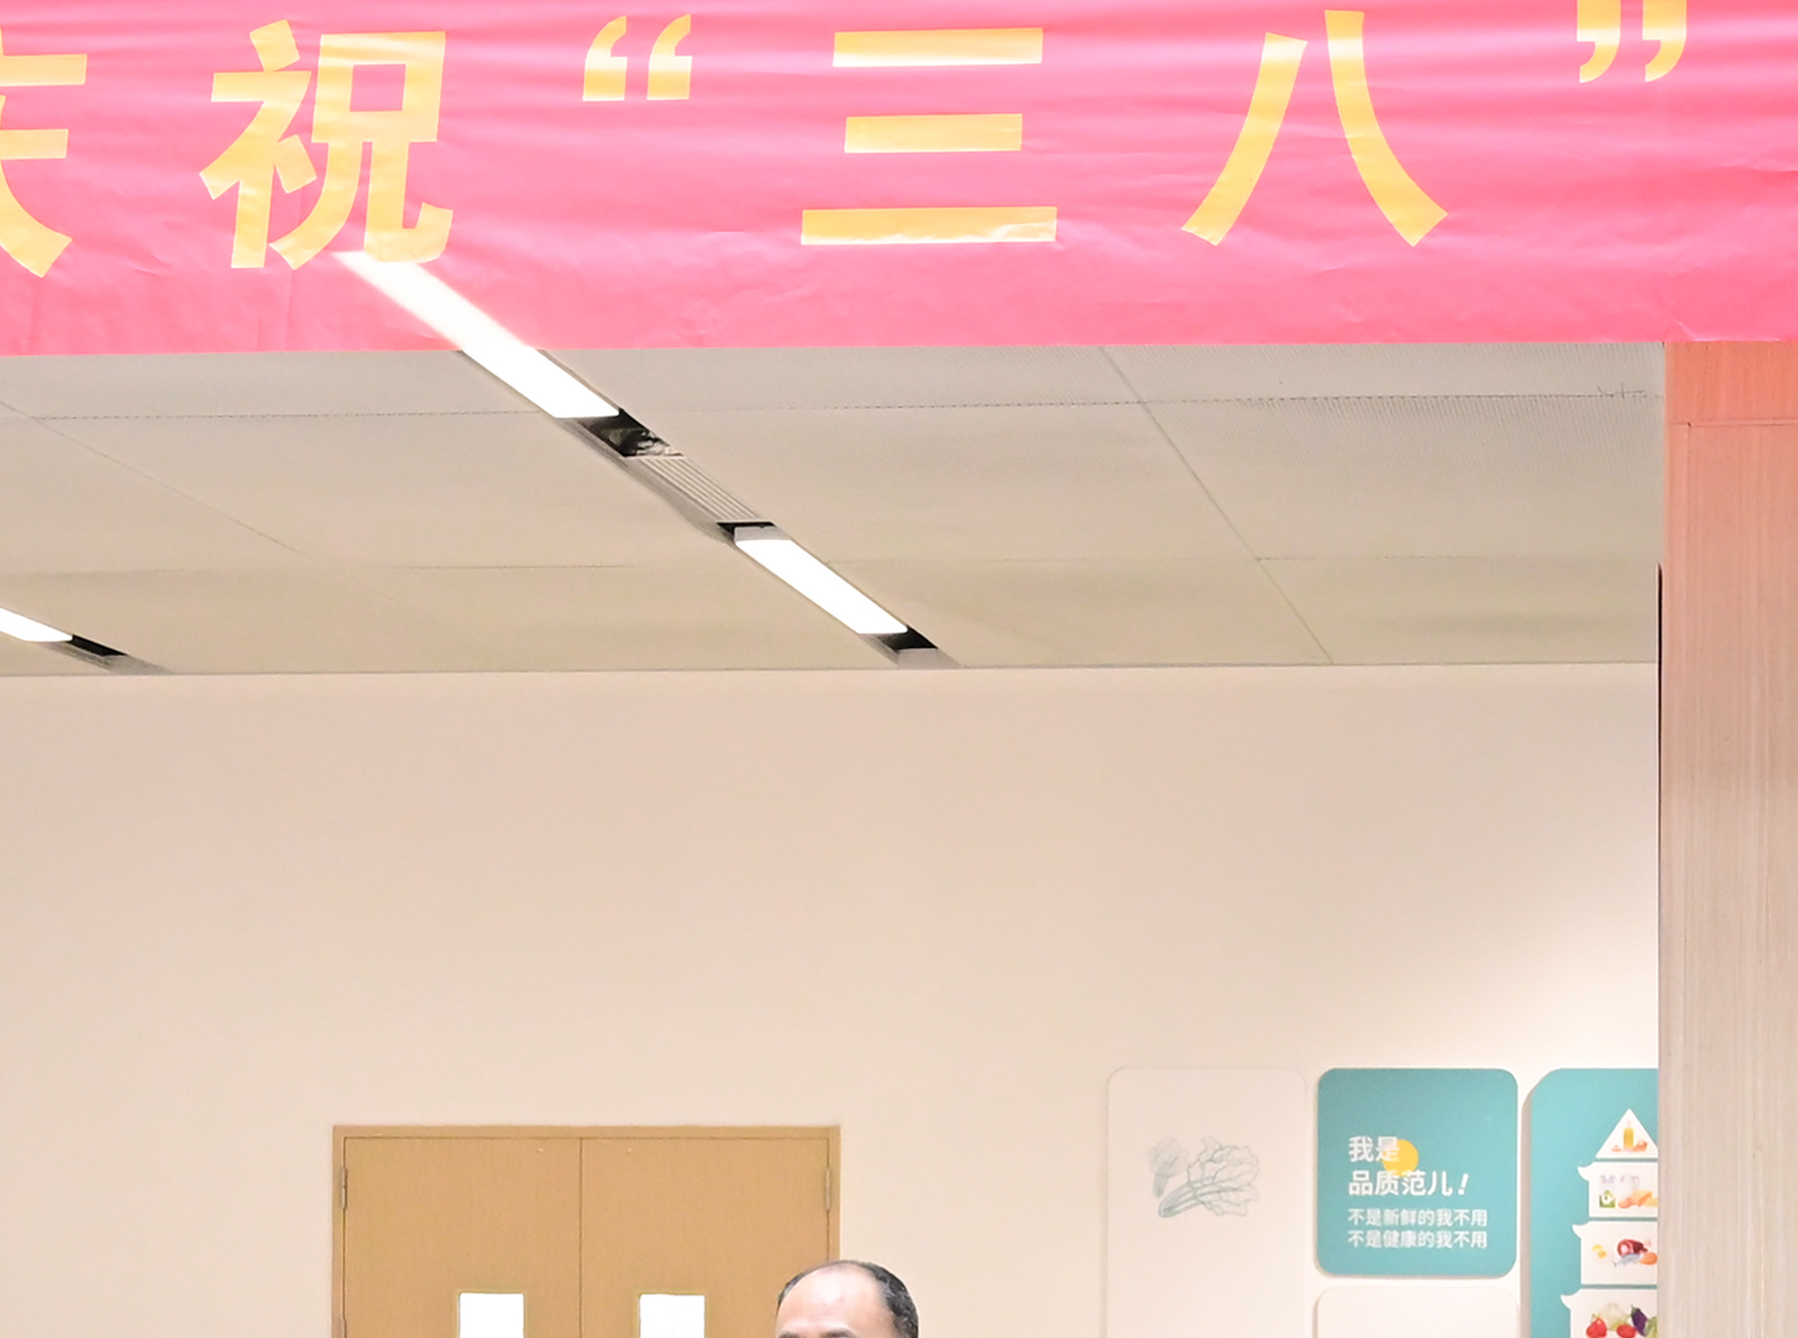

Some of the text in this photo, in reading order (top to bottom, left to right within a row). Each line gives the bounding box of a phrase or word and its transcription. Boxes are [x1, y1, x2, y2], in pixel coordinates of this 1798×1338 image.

[1348, 1135, 1400, 1162] 我是
[1348, 1208, 1488, 1227] 不是新鲜的我不用
[1348, 1231, 1488, 1249] 不是健康的我不用
